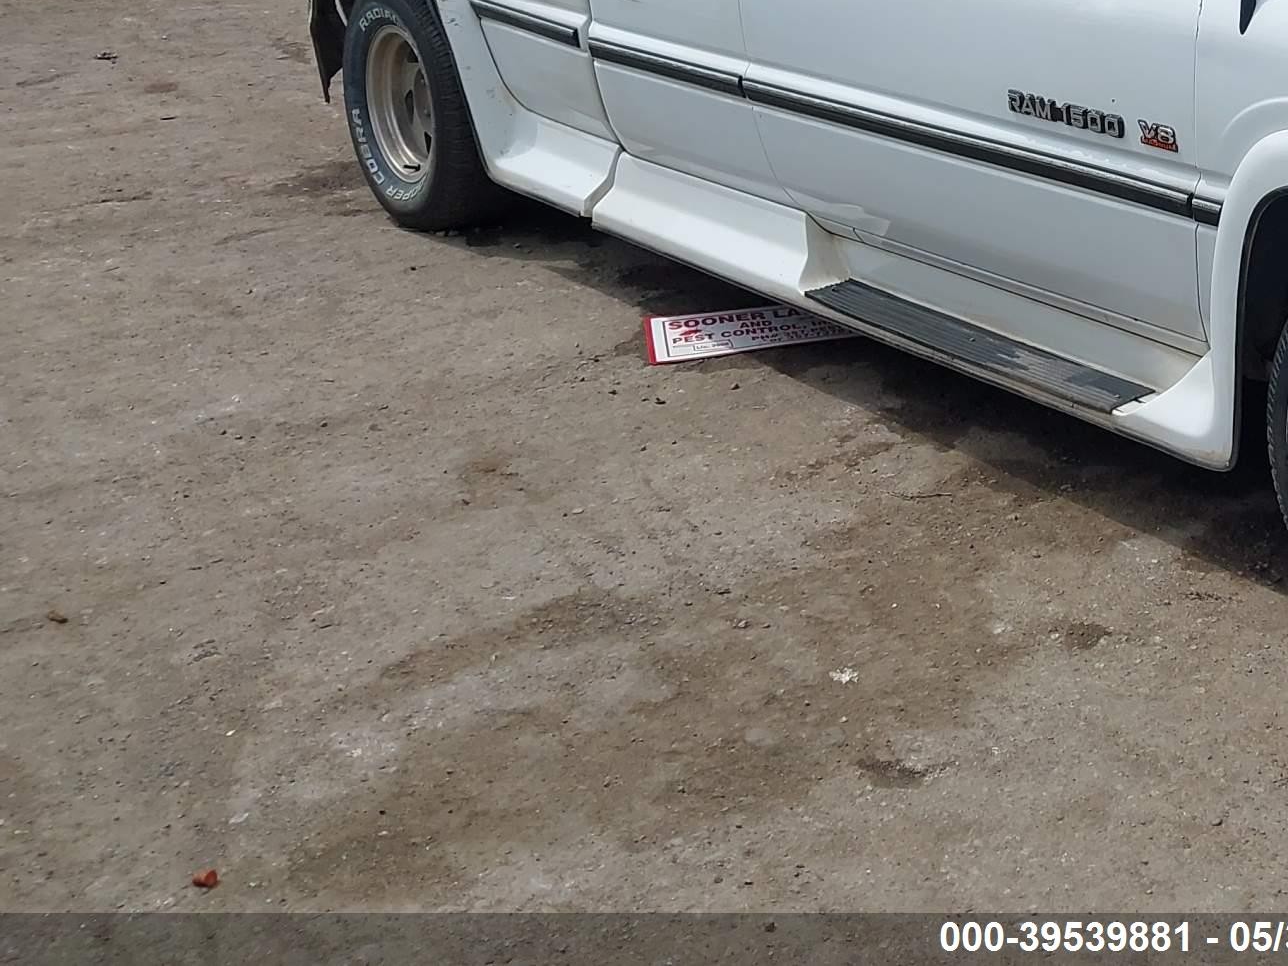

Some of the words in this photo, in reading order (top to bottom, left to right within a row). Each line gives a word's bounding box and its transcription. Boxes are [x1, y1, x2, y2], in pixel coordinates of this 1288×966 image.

[1008, 89, 1058, 122] RAM
[1061, 103, 1126, 139] 1500
[1137, 119, 1176, 146] V8
[352, 107, 385, 185] COBRA
[668, 311, 766, 331] SOONER
[740, 320, 773, 329] AND
[672, 332, 714, 345] PEST
